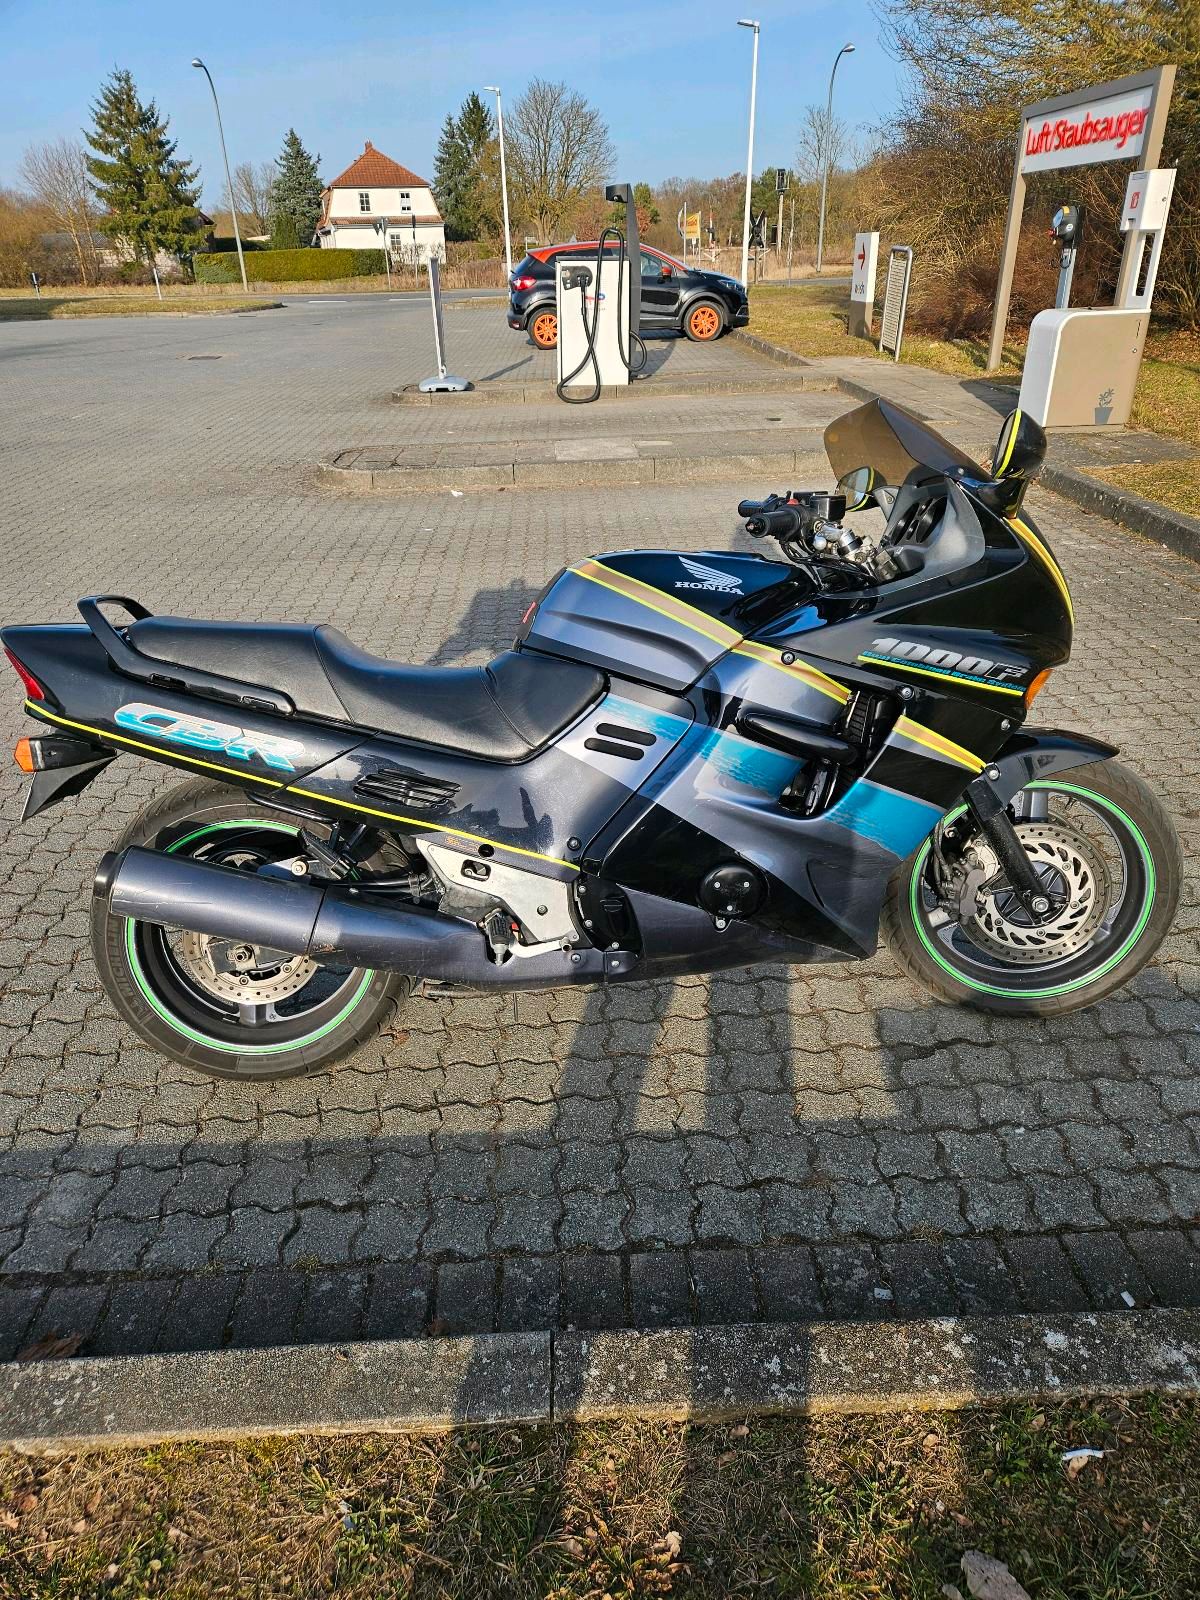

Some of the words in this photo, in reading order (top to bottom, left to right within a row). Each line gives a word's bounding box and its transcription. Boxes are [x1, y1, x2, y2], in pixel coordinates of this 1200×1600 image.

[1026, 108, 1148, 155] Luft/Staubsauger
[674, 581, 744, 595] HONDA
[872, 638, 1028, 680] 1000F
[114, 702, 305, 772] CBR
[107, 916, 135, 999] MICHELIN
